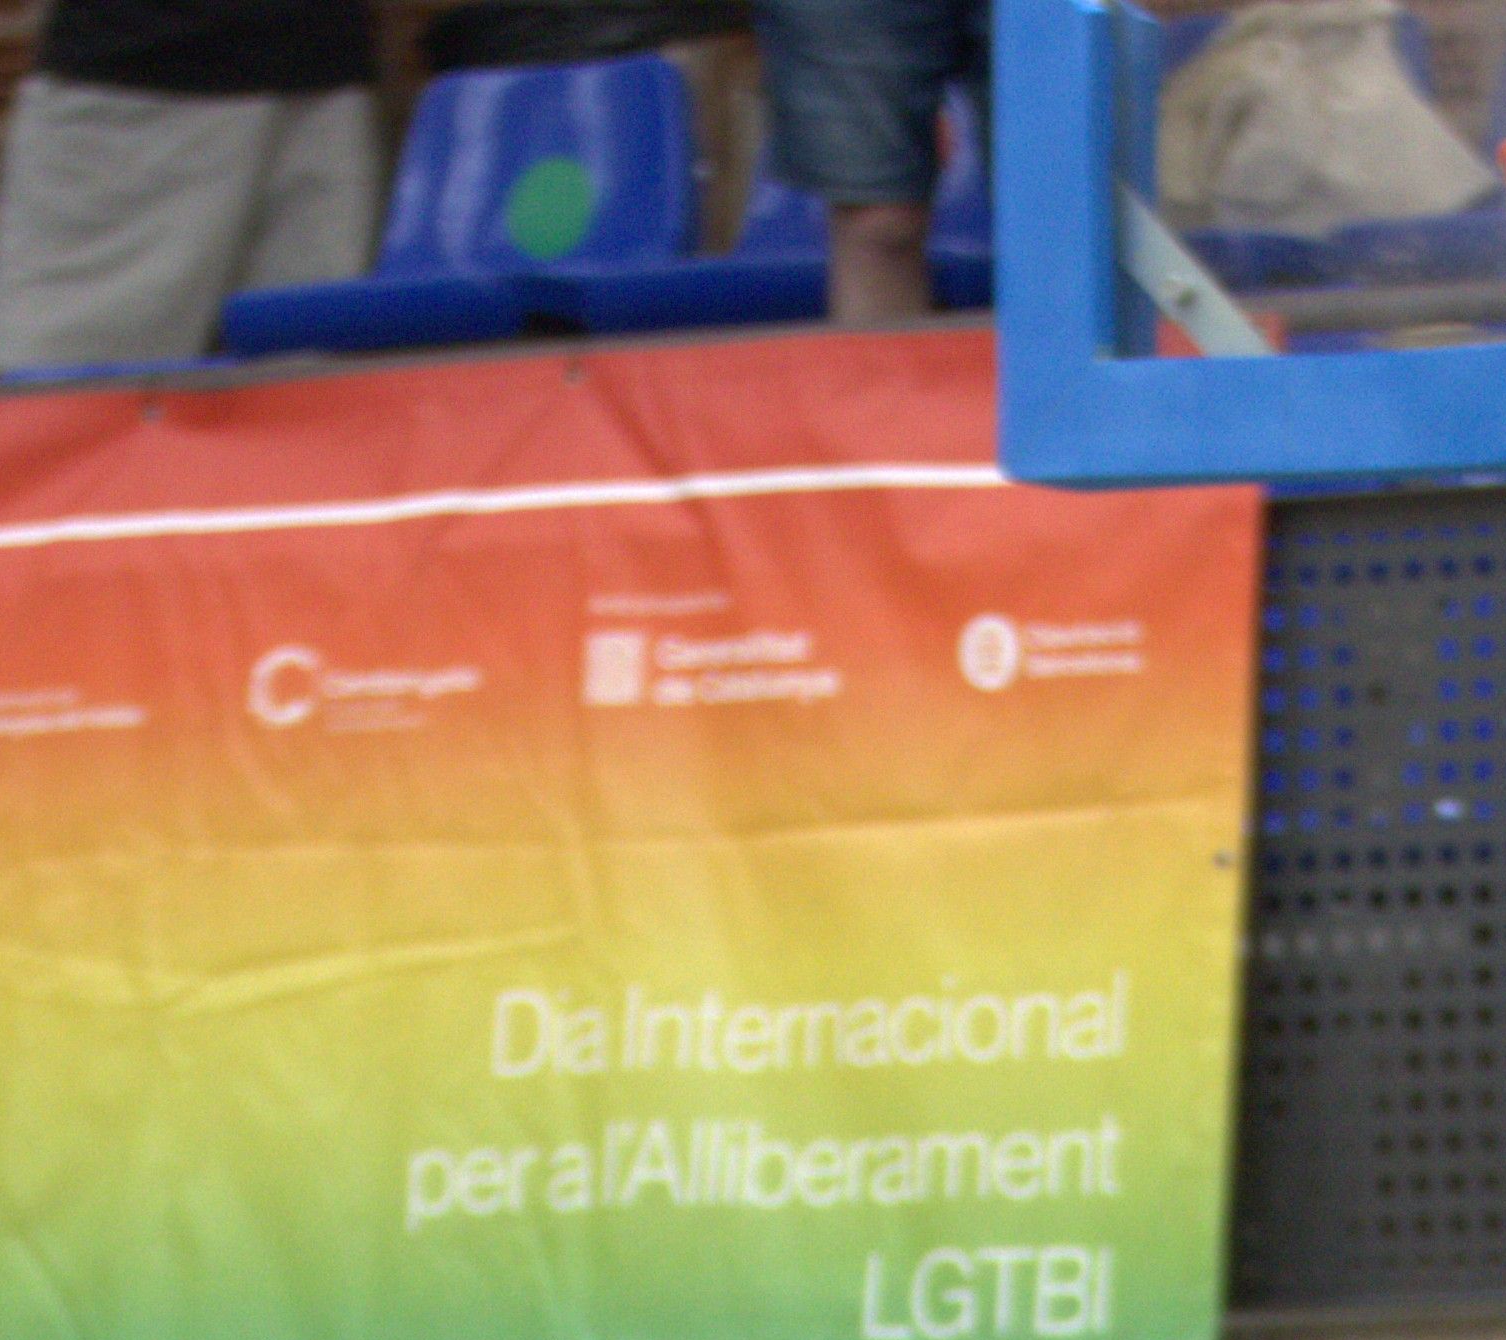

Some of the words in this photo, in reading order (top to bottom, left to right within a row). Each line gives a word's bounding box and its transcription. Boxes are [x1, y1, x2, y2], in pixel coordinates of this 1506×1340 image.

[492, 985, 608, 1078] Dia
[620, 969, 1128, 1073] Internacional
[404, 1144, 539, 1233] per
[547, 1142, 592, 1212] a
[604, 1113, 1124, 1209] l'Alliberament
[860, 1244, 1113, 1340] LGTBI
